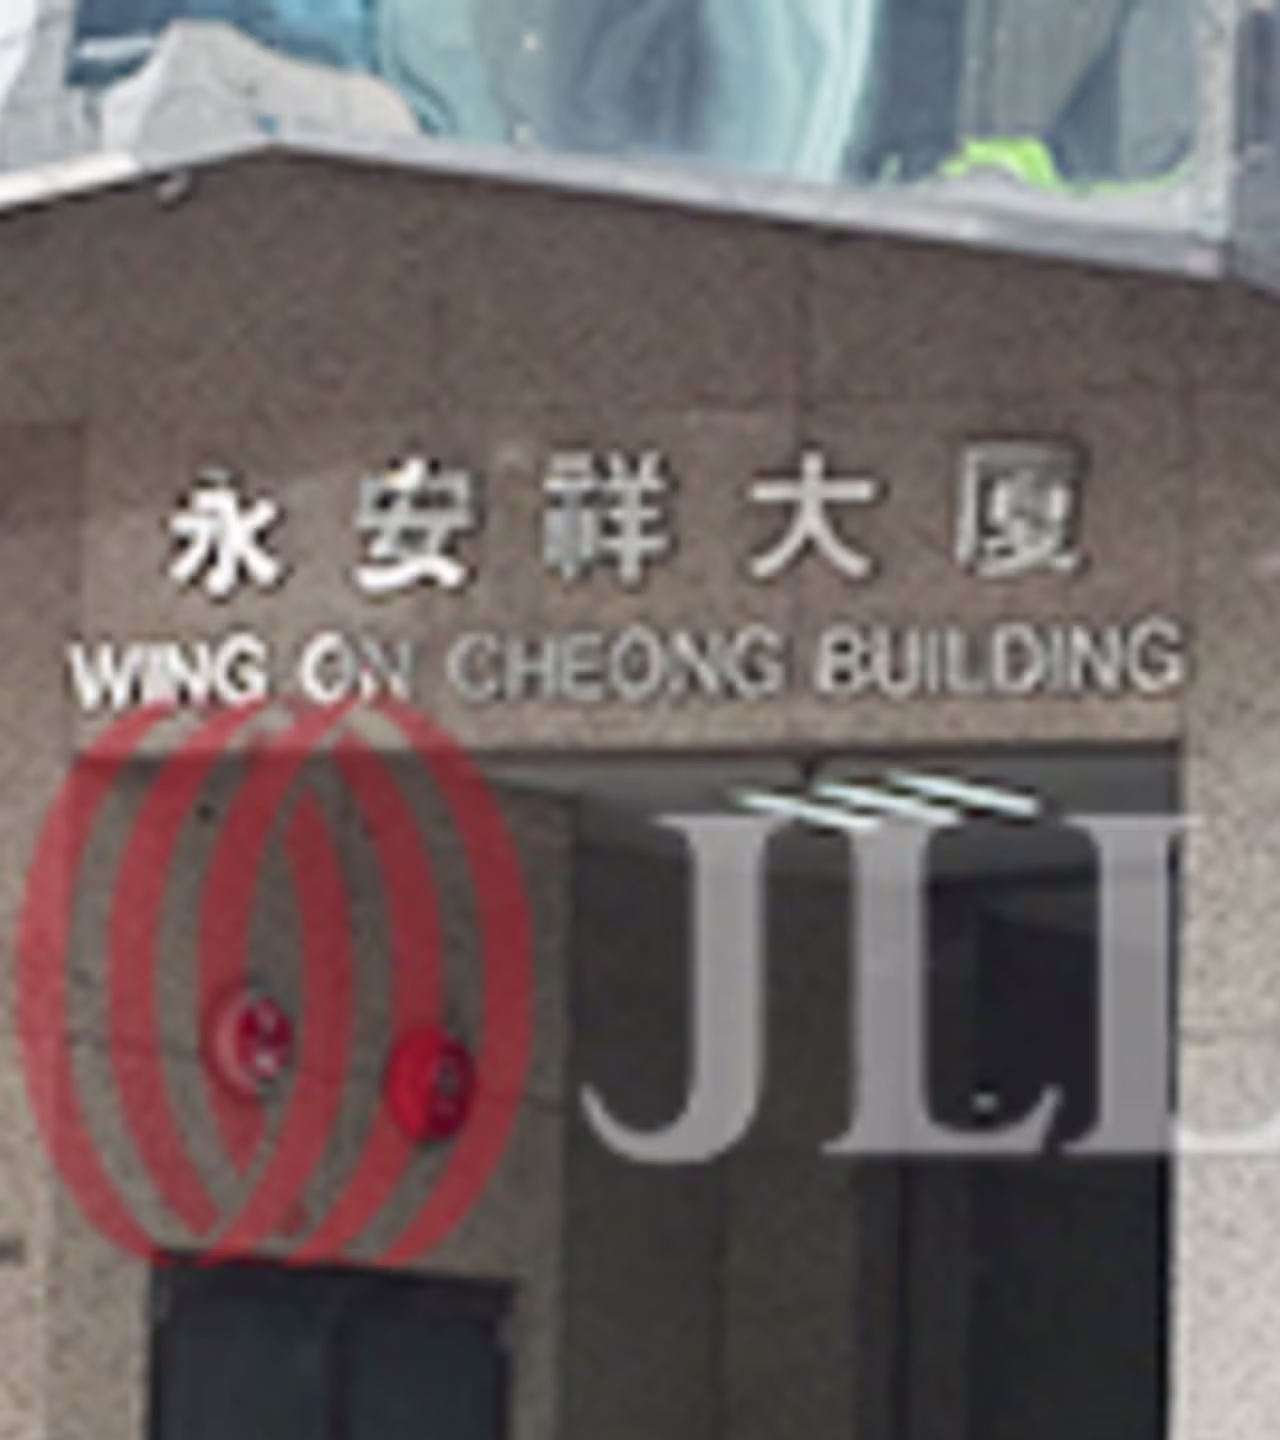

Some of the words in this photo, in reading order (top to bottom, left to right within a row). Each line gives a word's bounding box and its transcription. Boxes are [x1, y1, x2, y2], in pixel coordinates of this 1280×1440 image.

[65, 632, 269, 709] WING
[300, 632, 417, 703] ON
[446, 624, 784, 700] CHEONG
[817, 617, 1187, 696] BUILDING
